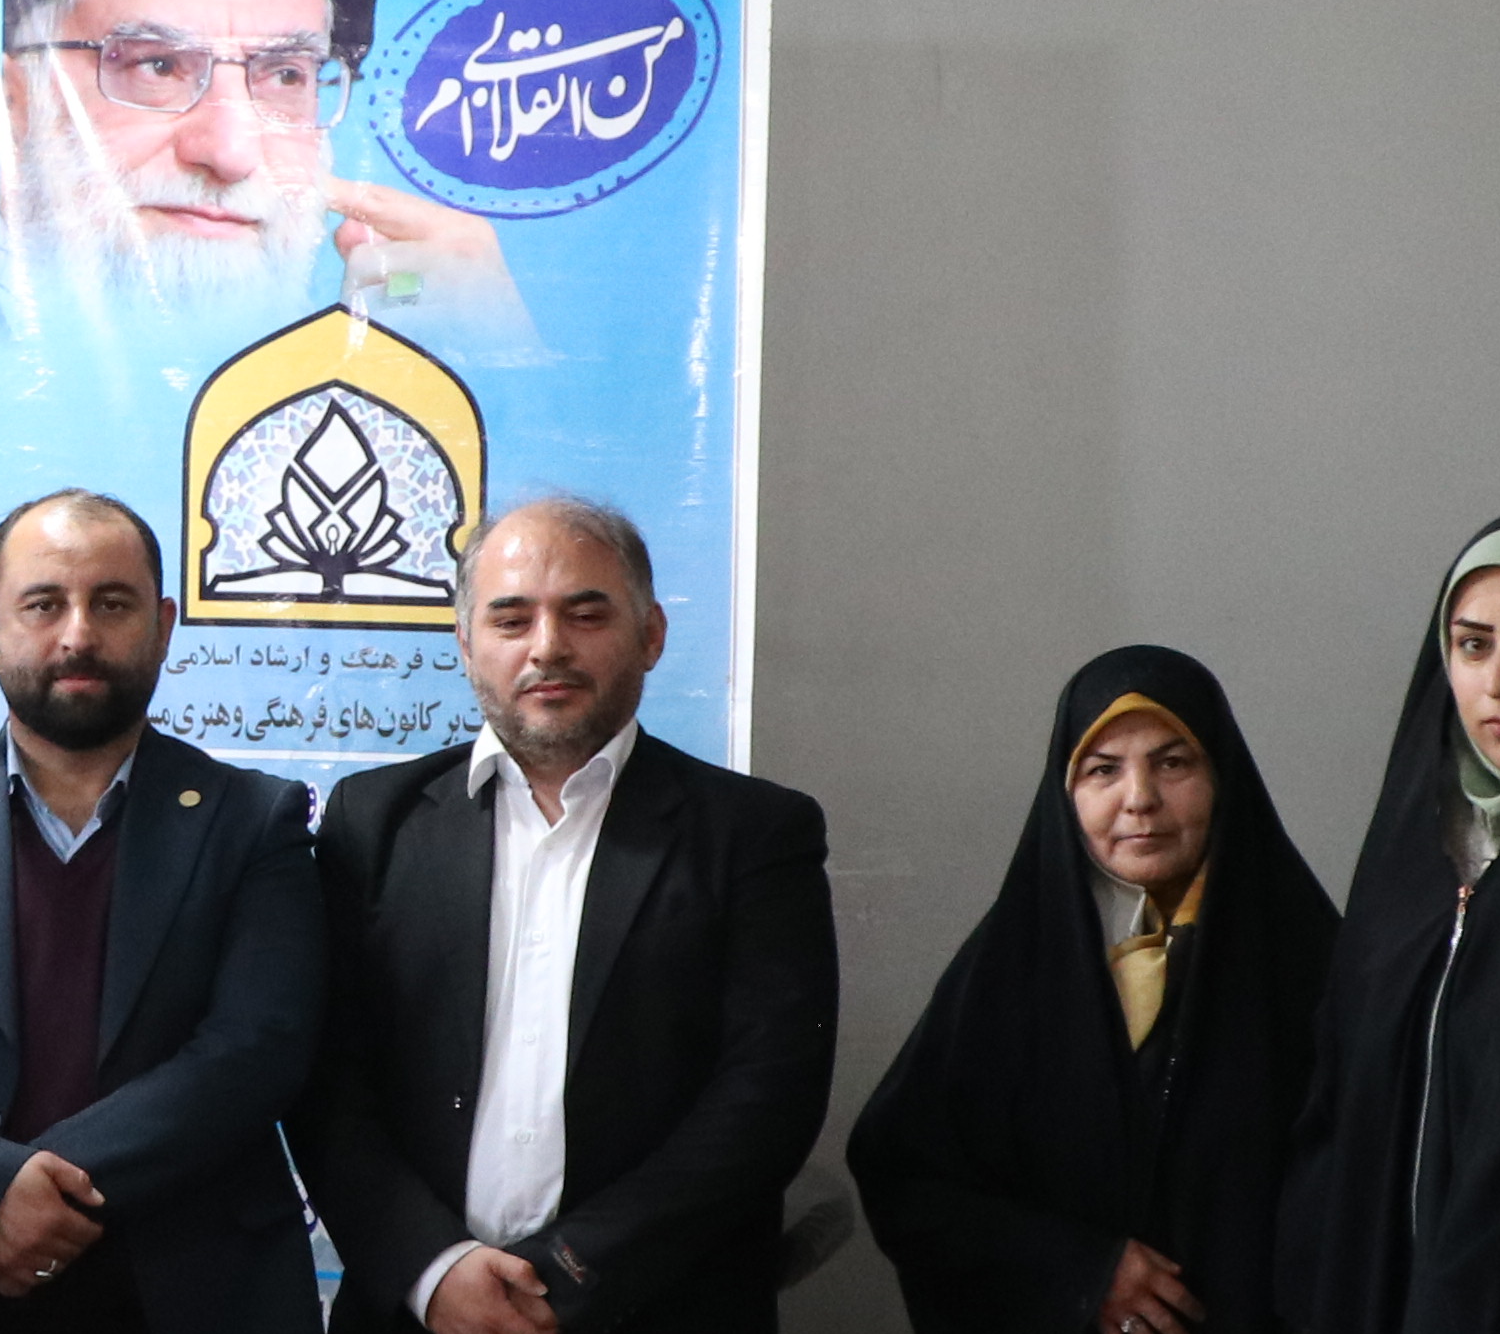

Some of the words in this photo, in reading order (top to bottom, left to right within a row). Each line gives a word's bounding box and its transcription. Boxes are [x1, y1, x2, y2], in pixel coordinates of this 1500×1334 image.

[583, 17, 684, 139] من
[166, 644, 241, 674] اسلامی
[250, 644, 310, 673] ارشاد
[318, 652, 331, 675] و
[341, 647, 424, 679] فرهنگ
[172, 702, 231, 740] هنری
[246, 696, 328, 742] فرهنگی
[442, 714, 460, 746] بر
